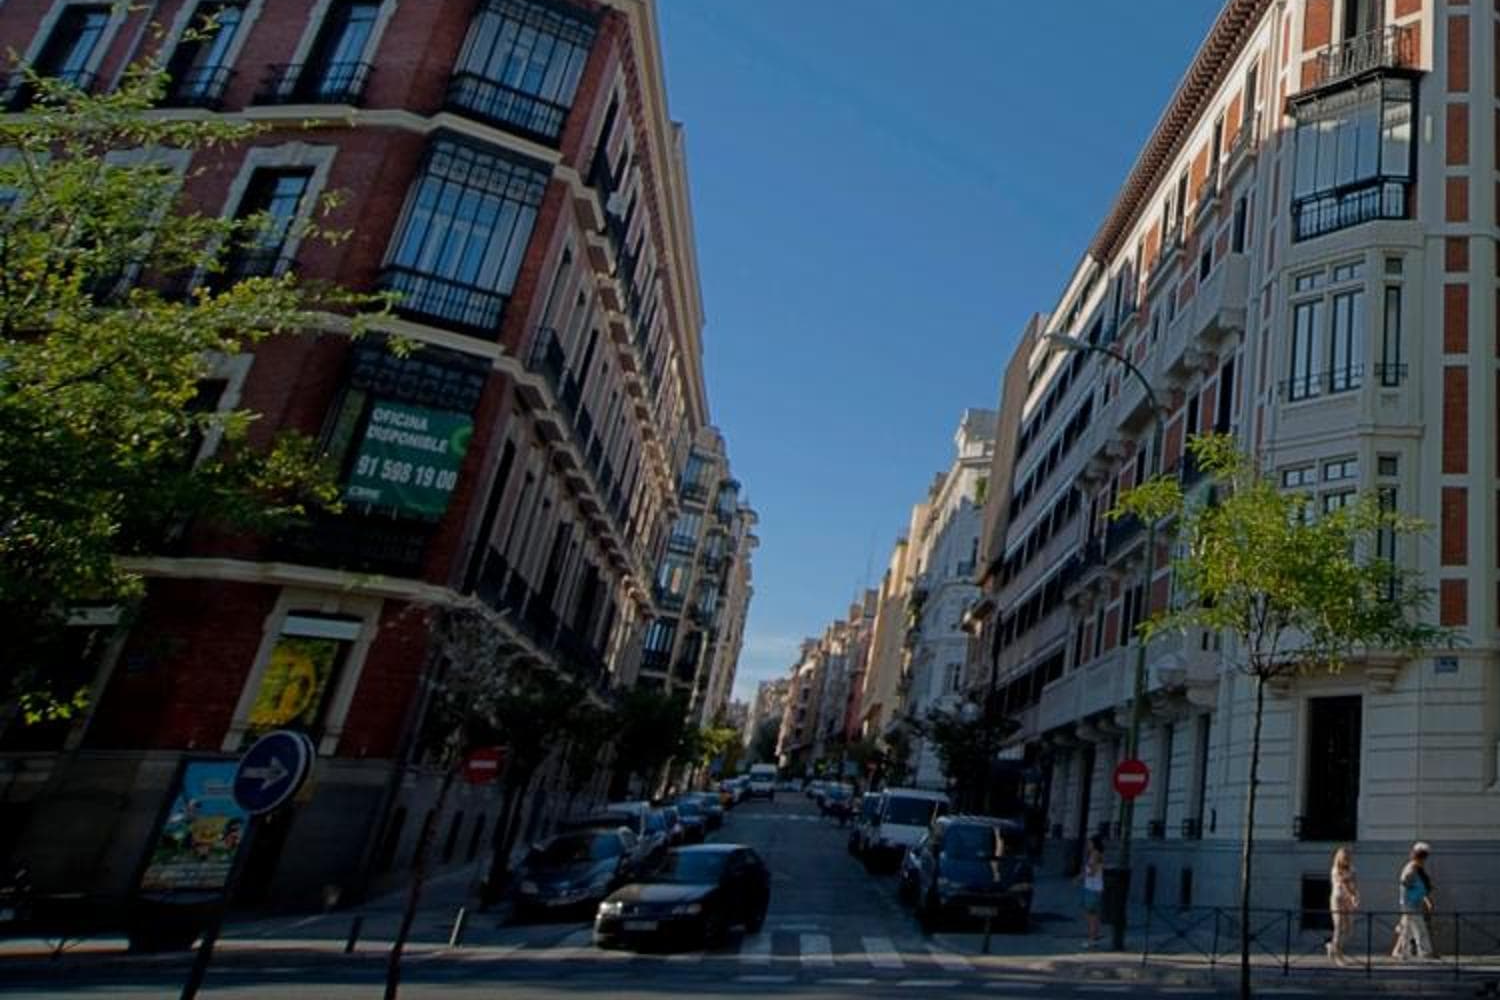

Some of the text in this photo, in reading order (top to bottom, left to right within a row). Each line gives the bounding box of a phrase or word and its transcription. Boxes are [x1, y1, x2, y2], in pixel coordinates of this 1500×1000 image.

[371, 408, 429, 431] OFICINA
[366, 425, 448, 453] DISPONIBLE
[357, 455, 379, 477] 91
[415, 465, 435, 488] 19
[435, 469, 458, 491] 00
